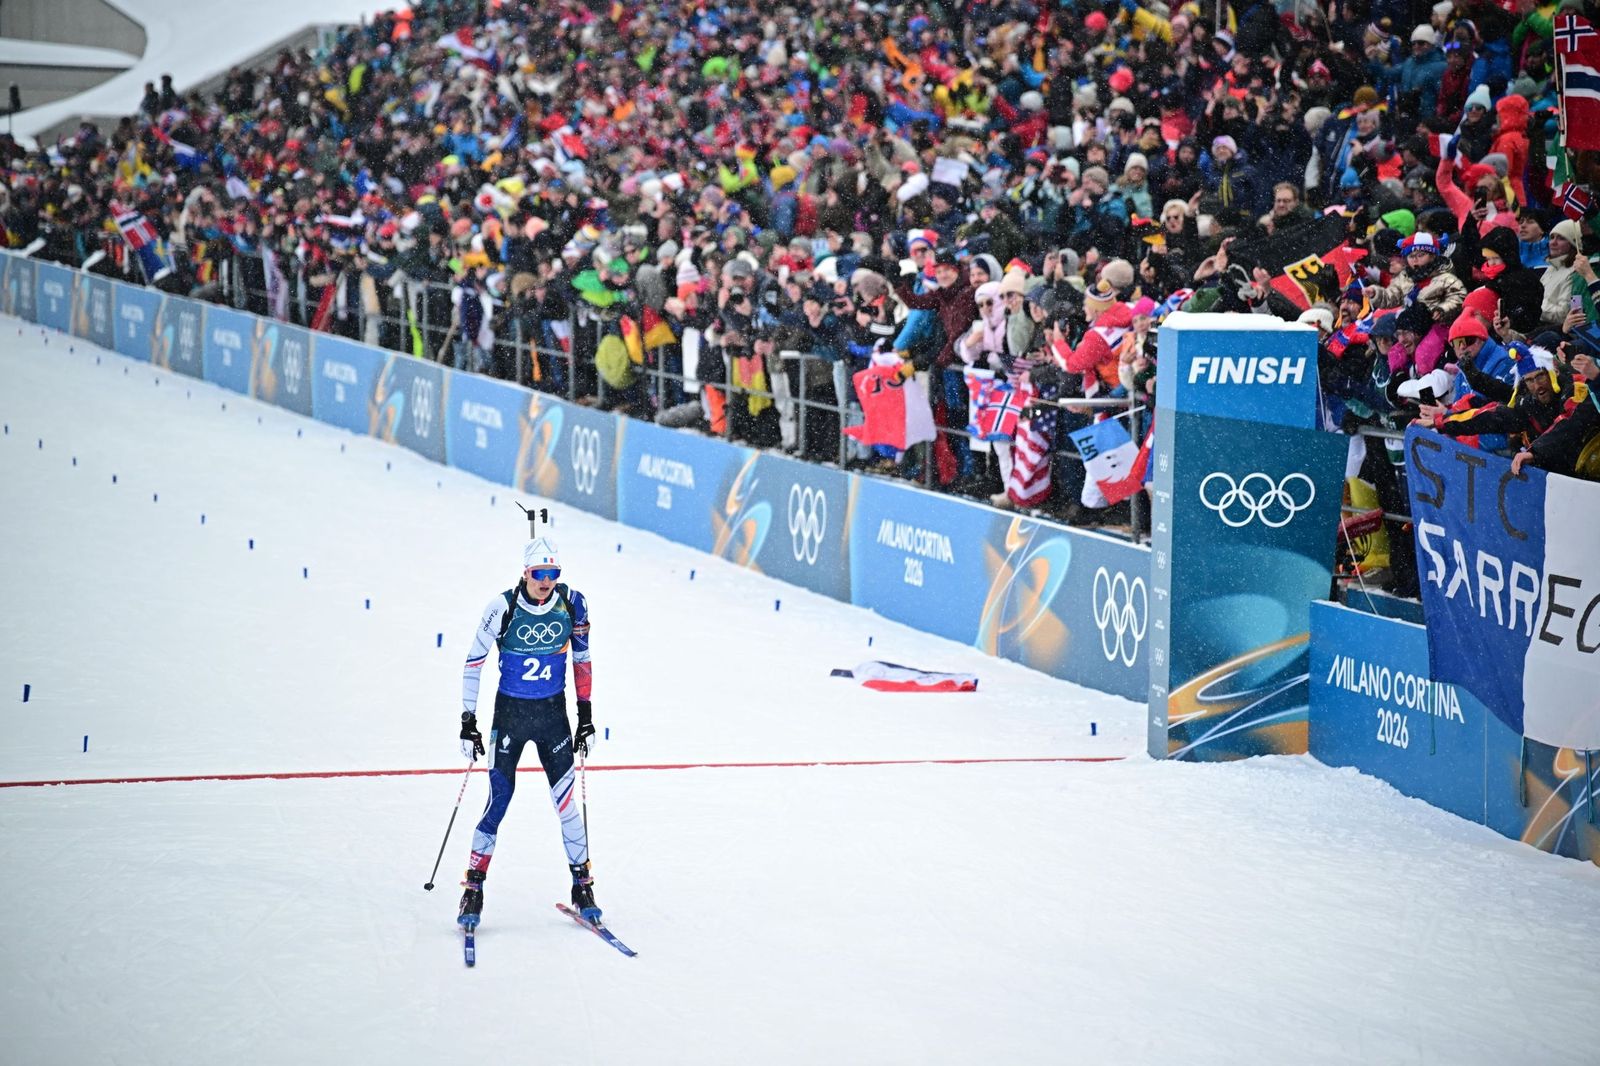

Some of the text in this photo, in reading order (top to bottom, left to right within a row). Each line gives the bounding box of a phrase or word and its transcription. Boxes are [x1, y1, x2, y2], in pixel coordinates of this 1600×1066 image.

[1187, 356, 1307, 384] FINISH
[1411, 436, 1529, 541] STC
[877, 518, 955, 565] MILANO CORTINA
[904, 556, 924, 588] 2026
[483, 612, 495, 632] CRAFT
[1326, 654, 1465, 724] MILANO CORTINA
[552, 736, 571, 754] CRAFT
[1376, 707, 1409, 750] 2026
